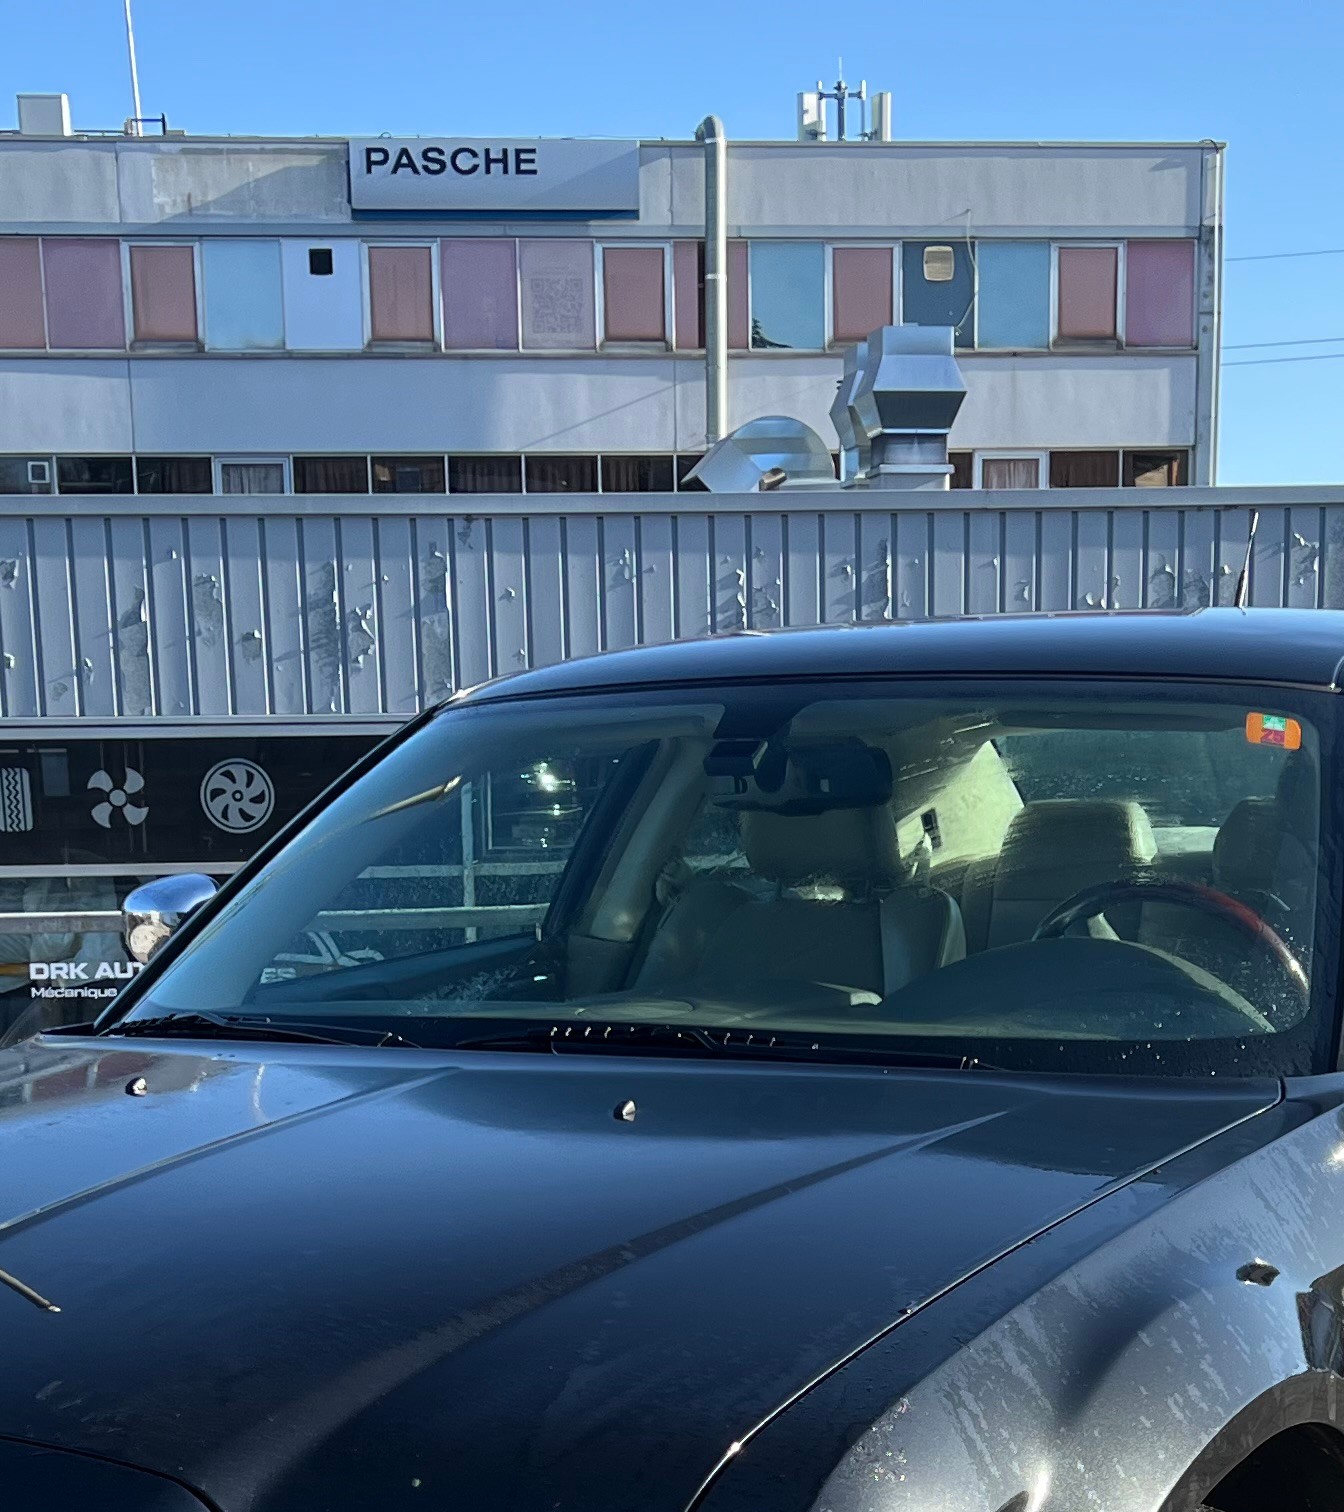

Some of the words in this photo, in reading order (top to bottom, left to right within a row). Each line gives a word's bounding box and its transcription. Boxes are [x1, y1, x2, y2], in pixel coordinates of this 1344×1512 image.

[365, 147, 538, 175] PASCHE
[29, 962, 89, 980] DRK
[30, 986, 118, 999] Mécanique
